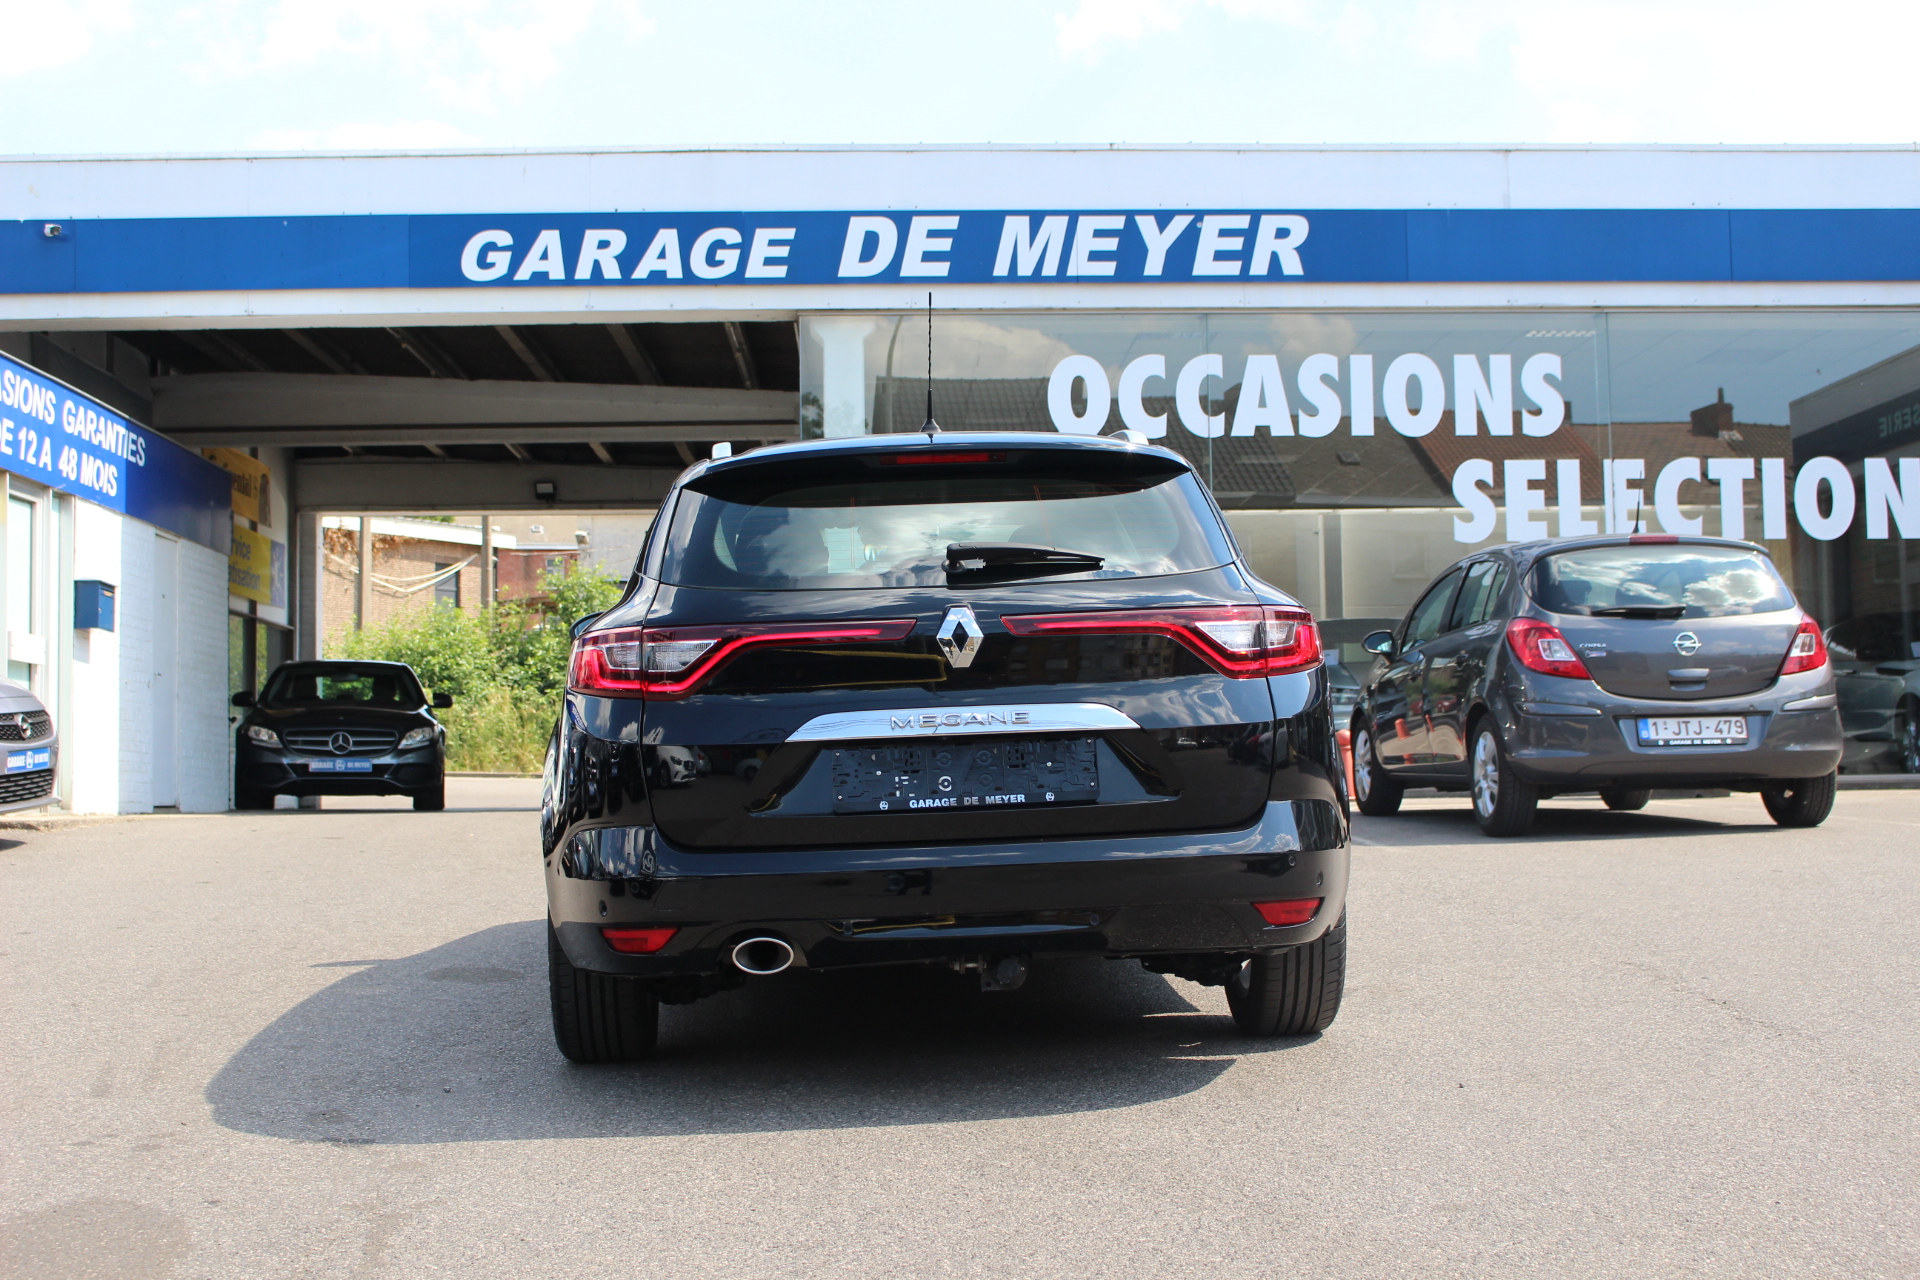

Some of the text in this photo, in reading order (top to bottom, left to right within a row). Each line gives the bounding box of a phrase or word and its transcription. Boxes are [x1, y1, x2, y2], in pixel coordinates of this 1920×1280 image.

[460, 214, 1311, 282] GARAGE DE MEYER
[0, 369, 146, 467] SIONS GARANTIES
[1047, 352, 1565, 438] OCCASIONS
[18, 426, 38, 465] 12
[38, 436, 52, 472] A
[58, 445, 78, 481] 48
[80, 452, 118, 497] MOIS
[1452, 456, 1920, 544] SELECTION
[890, 709, 1031, 730] MEGANE
[7, 755, 25, 768] GARAGE
[909, 794, 1026, 809] GARAGE DE MEYER
